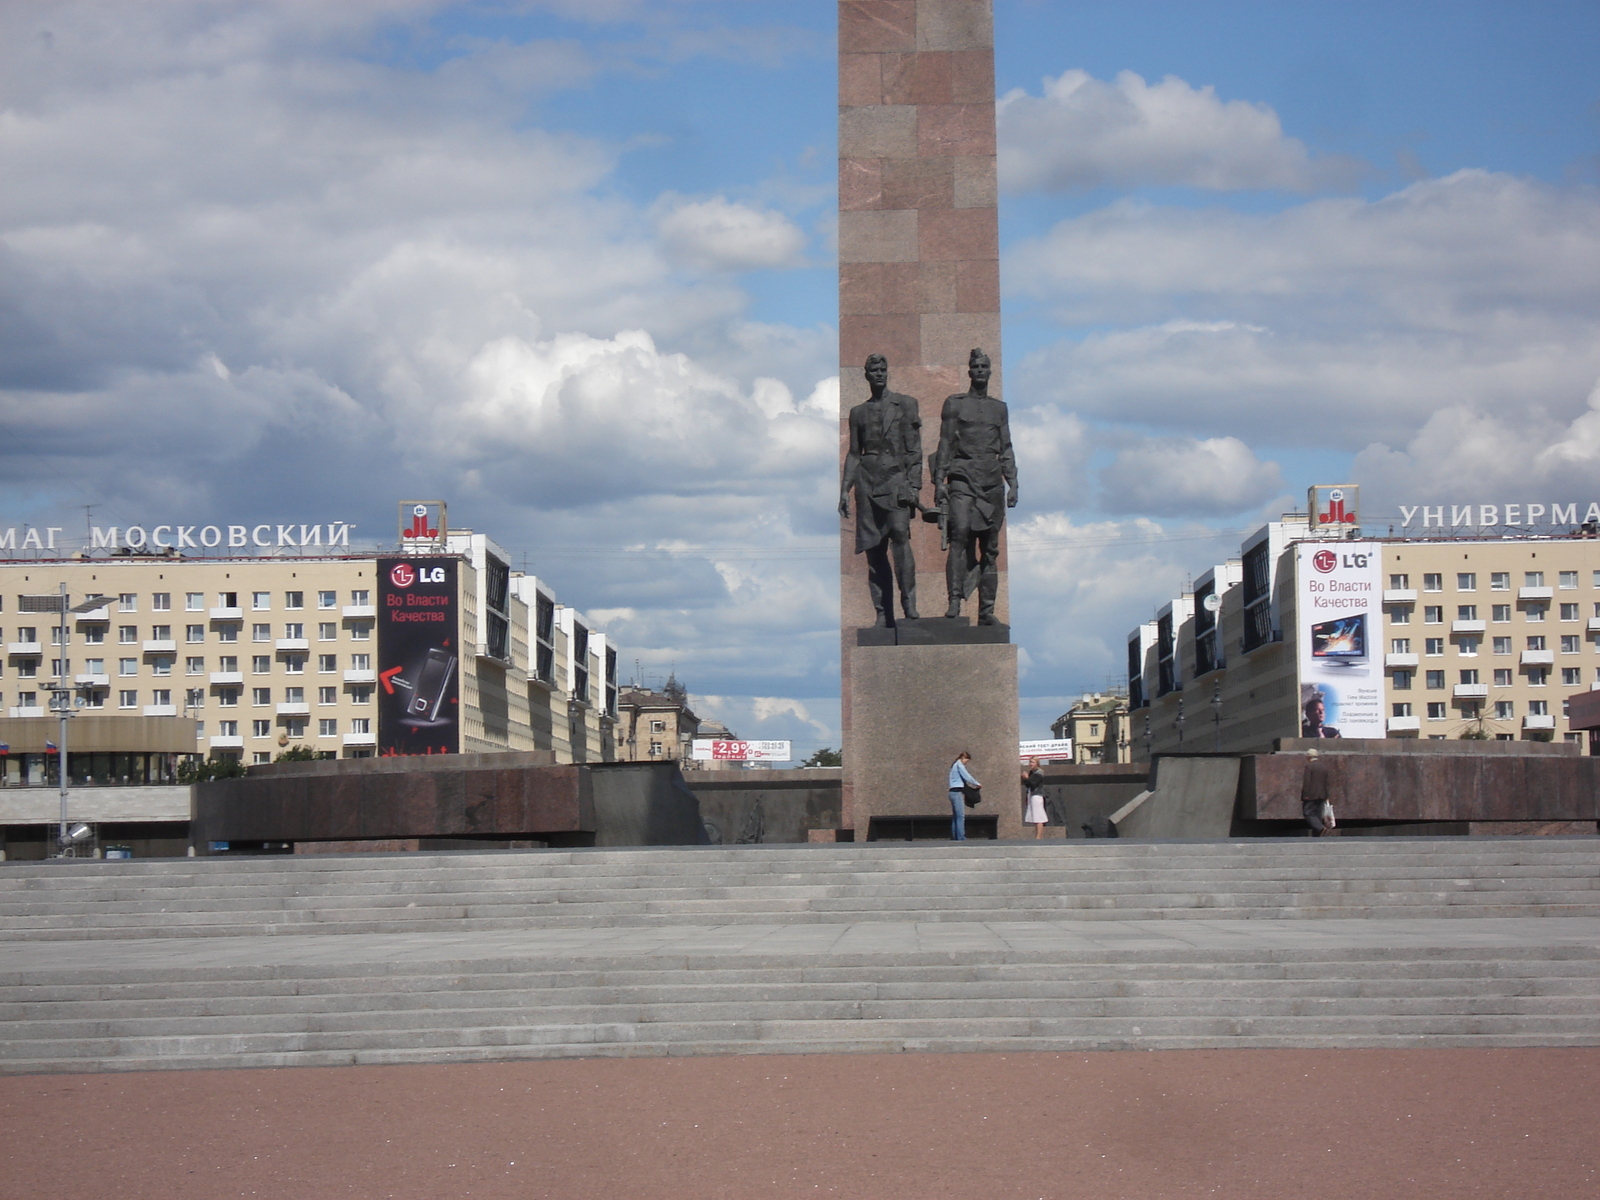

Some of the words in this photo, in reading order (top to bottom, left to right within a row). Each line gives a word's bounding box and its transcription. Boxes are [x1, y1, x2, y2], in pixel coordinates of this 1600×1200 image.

[1398, 502, 1600, 527] УНИВЕРМА
[0, 527, 63, 550] МАГ
[1342, 554, 1368, 568] LG
[419, 567, 446, 583] LG
[1309, 580, 1325, 592] Во
[1329, 580, 1372, 592] Власти
[386, 593, 403, 607] Во
[406, 593, 449, 607] Власти
[1314, 596, 1368, 608] Качества
[391, 609, 445, 622] Качества
[719, 742, 753, 755] 2,9%
